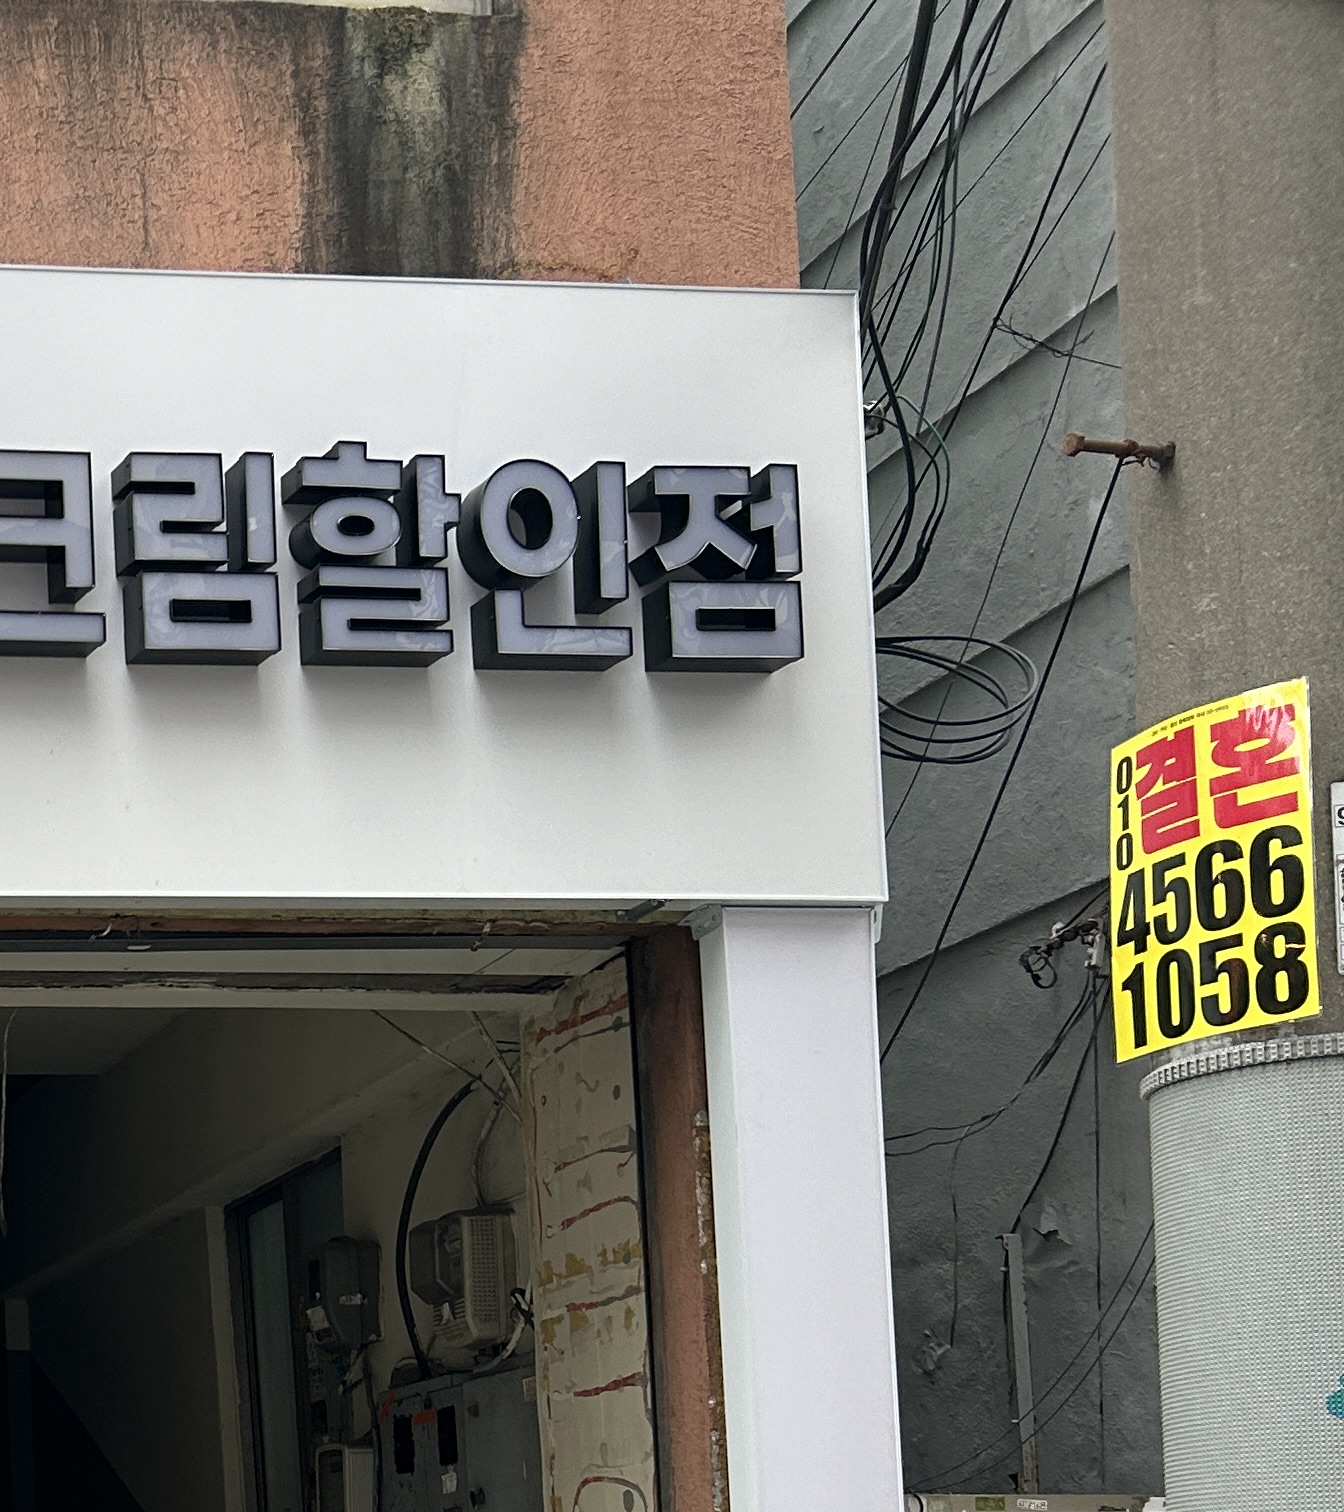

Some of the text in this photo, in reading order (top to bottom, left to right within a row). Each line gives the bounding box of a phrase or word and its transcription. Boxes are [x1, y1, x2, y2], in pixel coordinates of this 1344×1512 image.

[1116, 755, 1134, 872] 010
[1136, 702, 1301, 856] 결혼
[1117, 824, 1306, 955] 4566
[1122, 921, 1310, 1050] 1058
